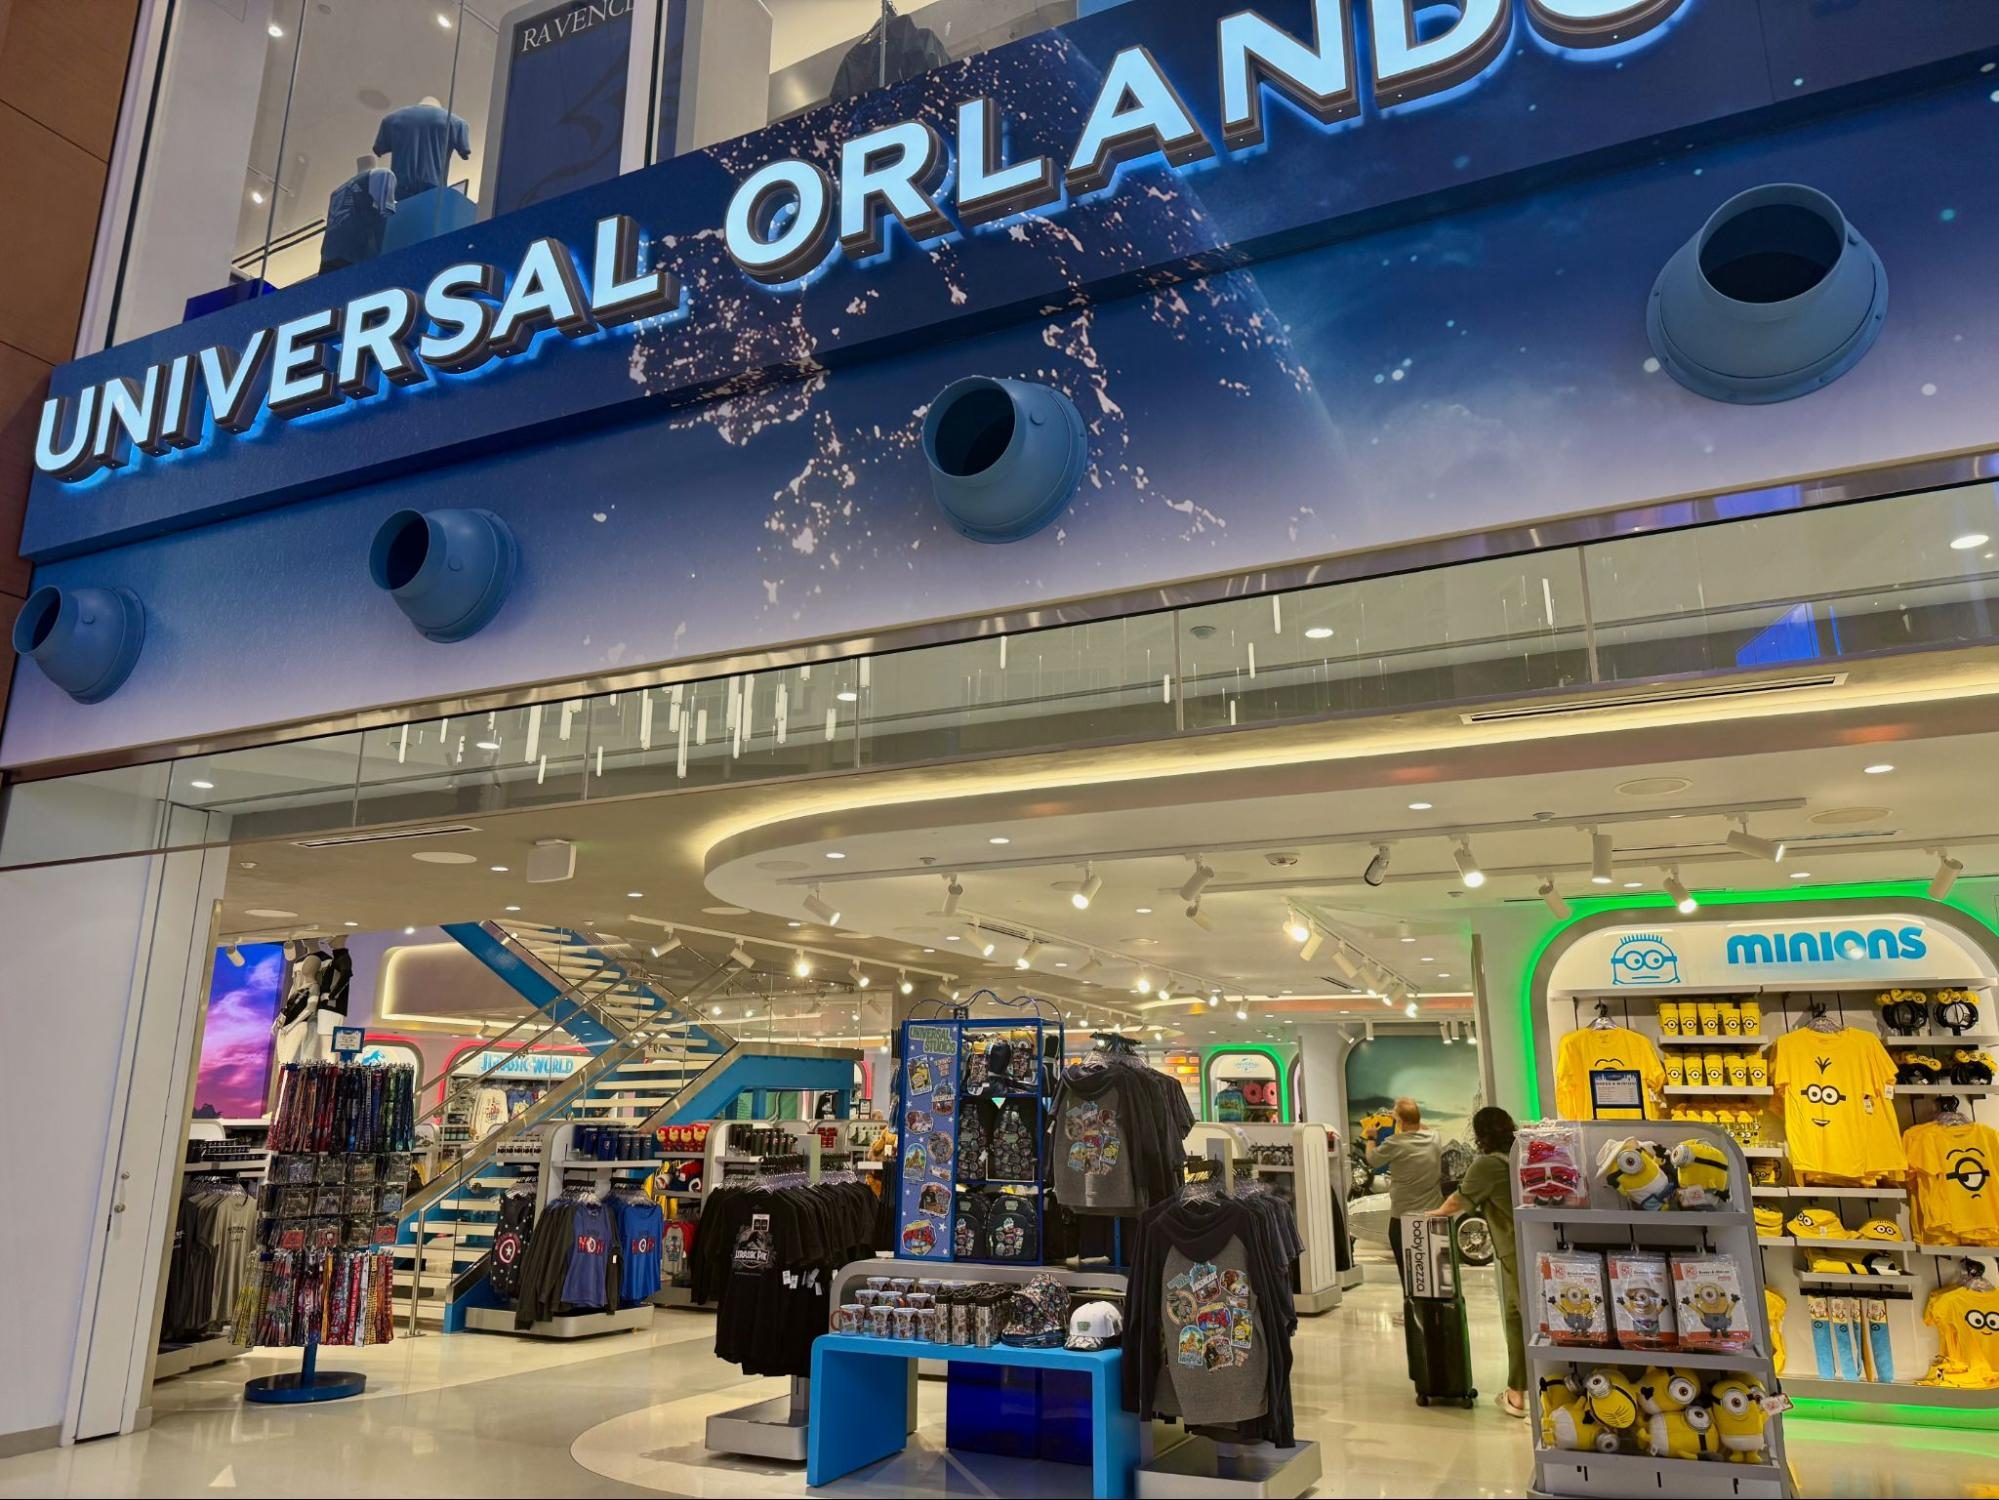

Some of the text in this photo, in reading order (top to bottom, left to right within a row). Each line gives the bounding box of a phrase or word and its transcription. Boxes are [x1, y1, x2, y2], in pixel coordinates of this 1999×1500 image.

[34, 0, 1666, 473] UNIVERSAL ORLAND
[533, 1055, 574, 1073] WORLD
